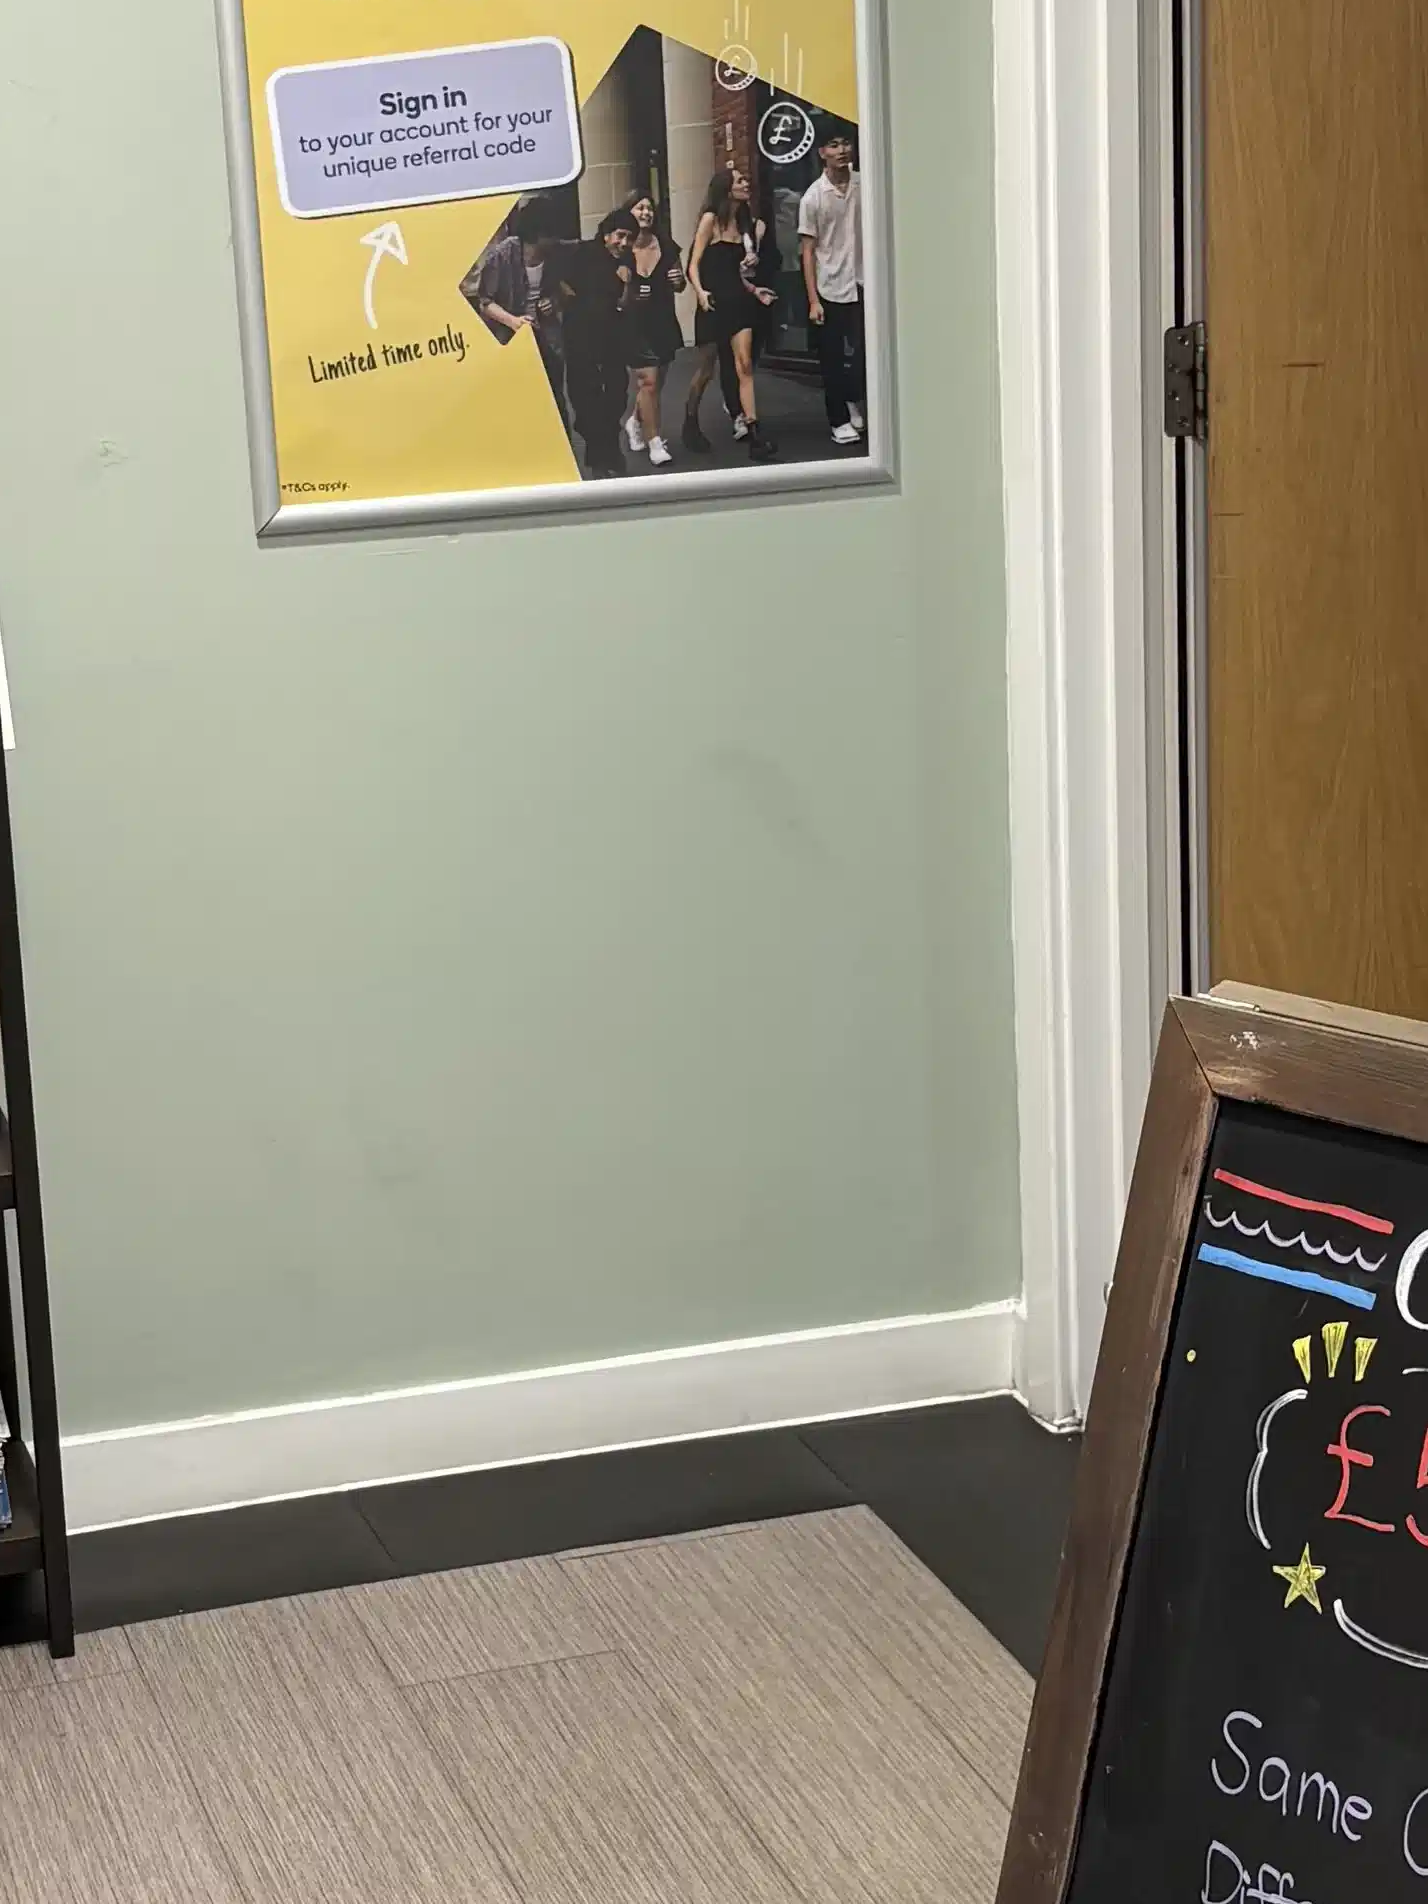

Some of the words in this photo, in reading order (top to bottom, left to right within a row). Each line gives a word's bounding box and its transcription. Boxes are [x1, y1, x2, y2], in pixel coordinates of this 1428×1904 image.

[379, 90, 438, 119] Sign
[442, 86, 468, 109] in
[299, 135, 322, 154] to
[327, 130, 373, 156] your
[379, 116, 470, 144] account
[474, 111, 502, 132] for
[507, 108, 553, 134] your
[323, 154, 397, 179] unique
[403, 140, 479, 169] referral
[484, 134, 537, 158] code
[308, 343, 378, 384] Limited
[381, 343, 423, 367] time
[428, 323, 471, 363] only.
[1207, 1709, 1375, 1846] Same
